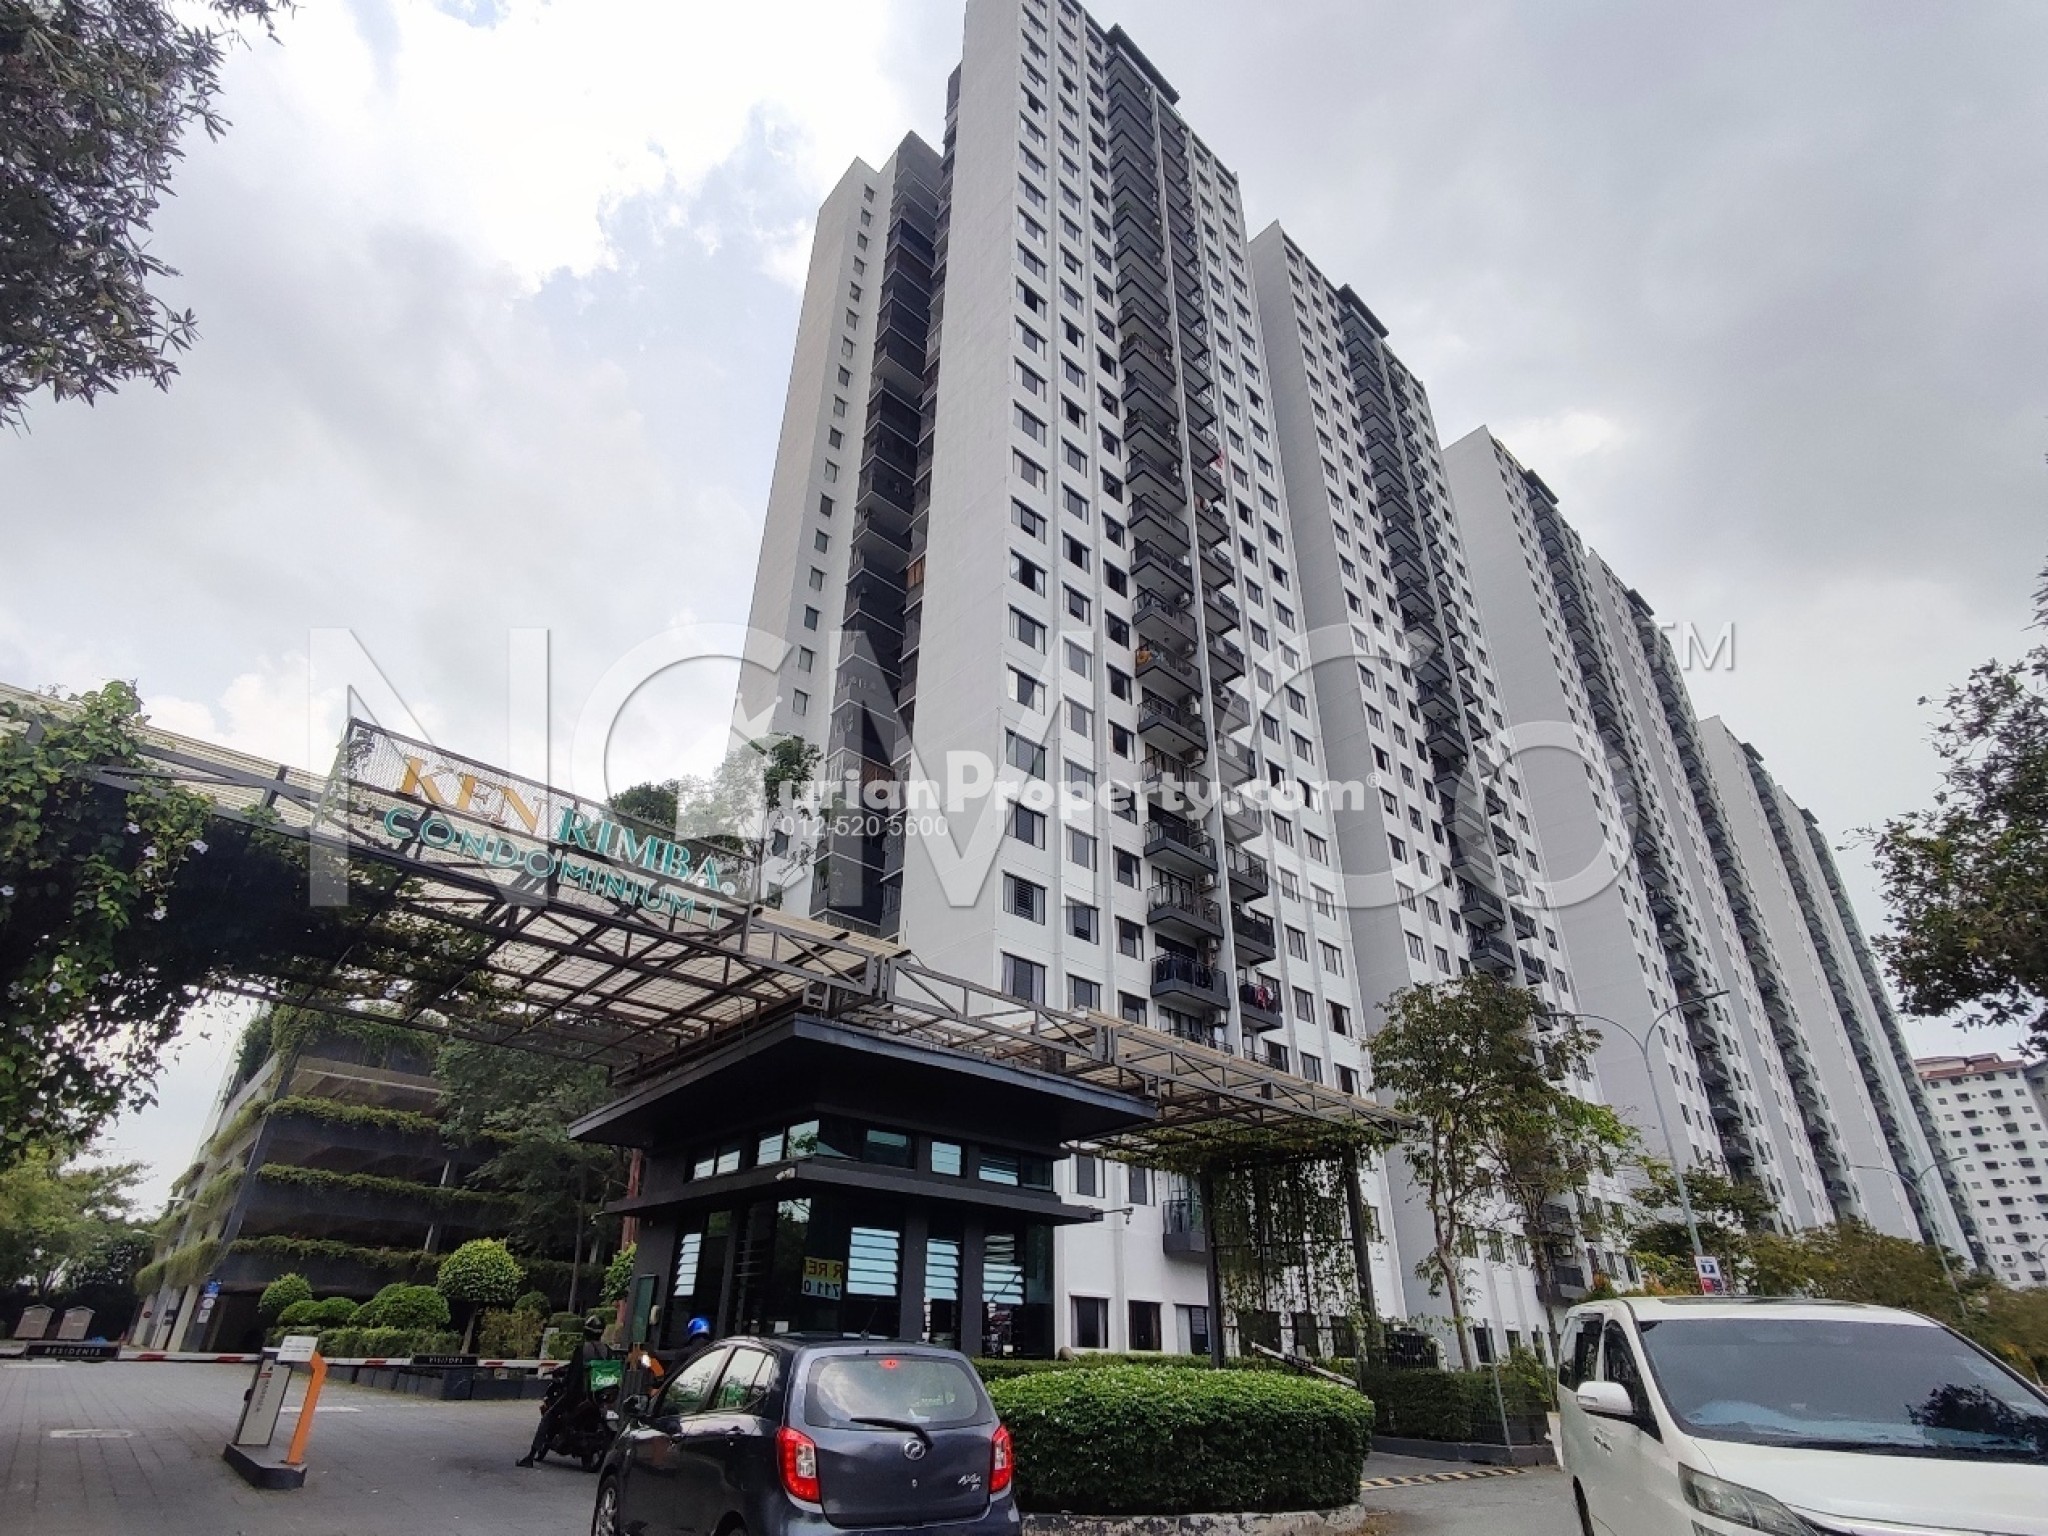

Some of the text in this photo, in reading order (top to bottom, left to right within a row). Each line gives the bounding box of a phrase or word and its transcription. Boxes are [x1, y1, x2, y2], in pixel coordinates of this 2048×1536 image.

[383, 807, 697, 924] CONDOMINIUM
[399, 754, 724, 893] KEN RIMBA
[44, 1346, 101, 1356] RESIDENTS
